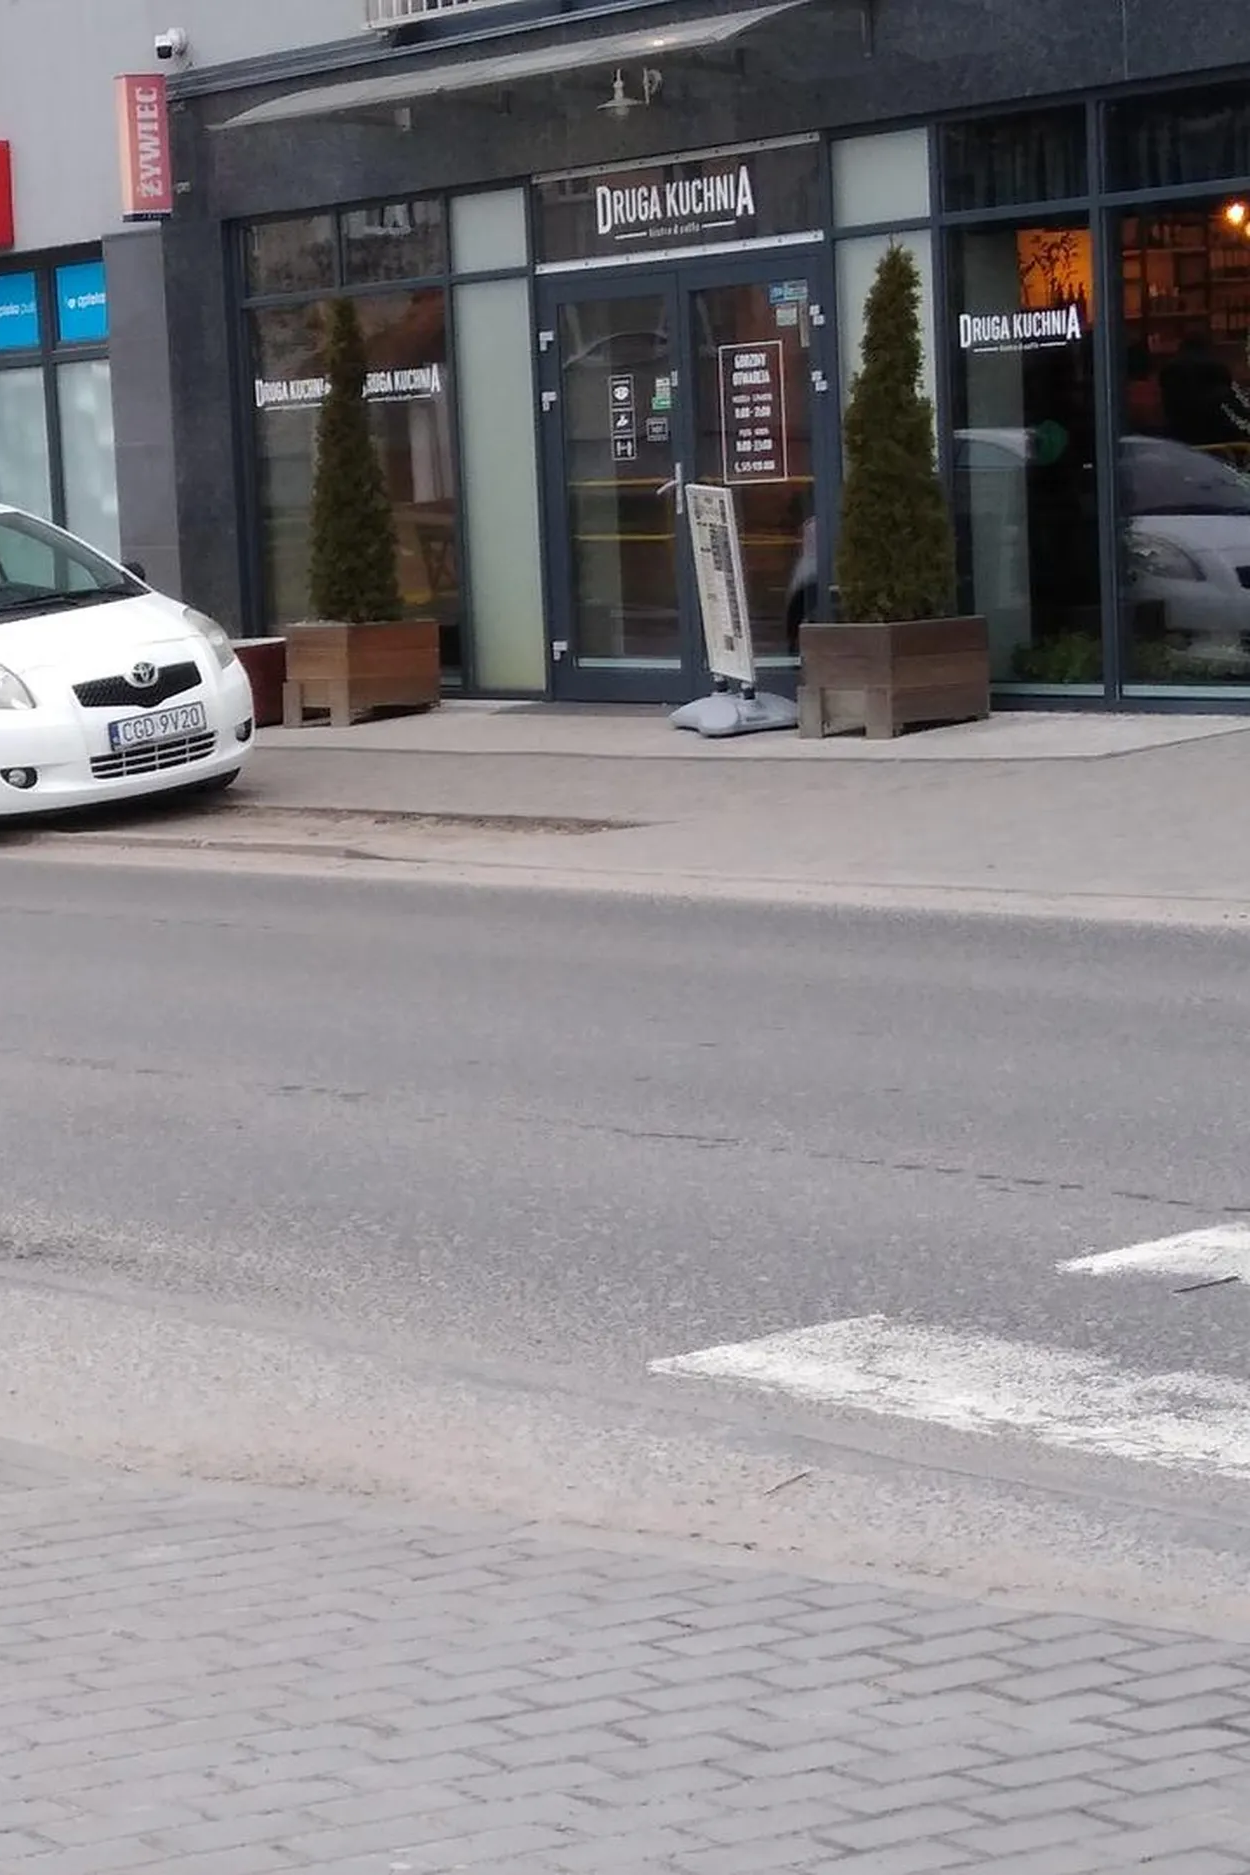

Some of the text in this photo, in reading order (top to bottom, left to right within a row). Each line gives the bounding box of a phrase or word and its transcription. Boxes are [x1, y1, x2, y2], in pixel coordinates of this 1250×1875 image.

[136, 86, 163, 197] ŻYWIEC
[596, 165, 755, 235] DRUGA KUCHNIA
[959, 303, 1081, 348] DRUGA KUCHNIA
[122, 718, 155, 742] CGD
